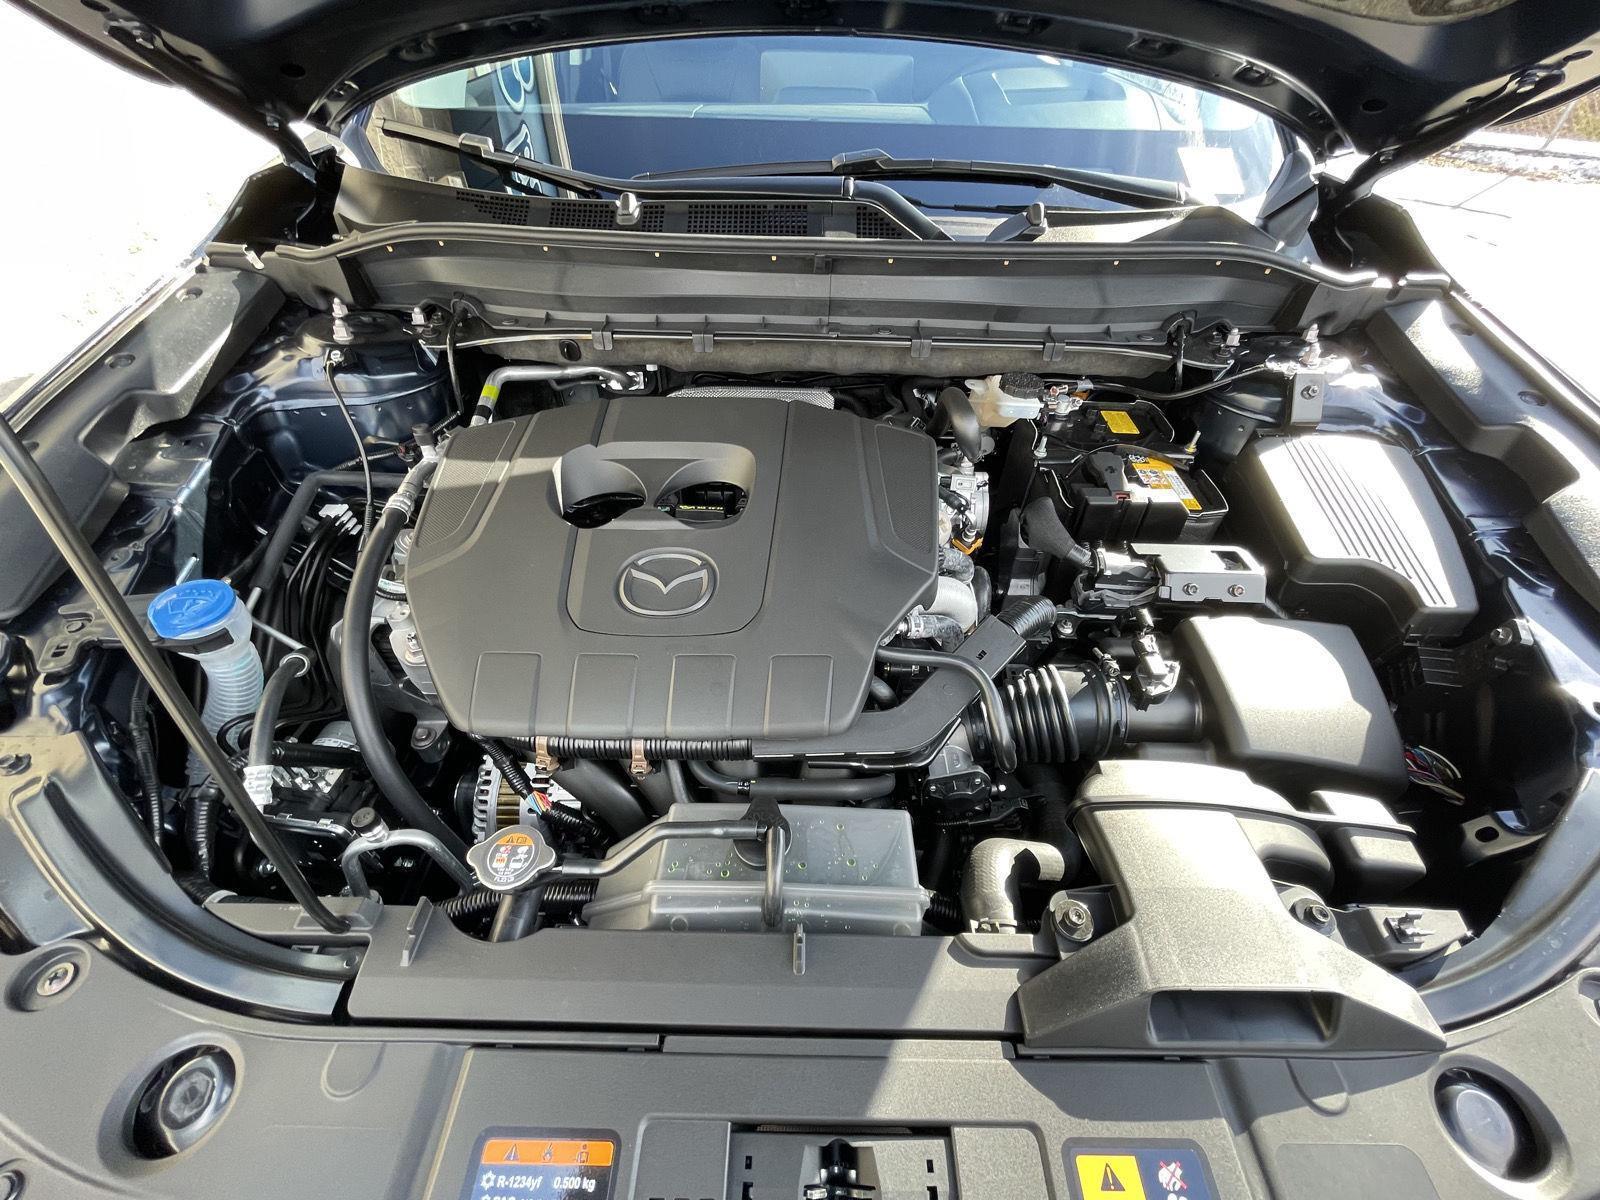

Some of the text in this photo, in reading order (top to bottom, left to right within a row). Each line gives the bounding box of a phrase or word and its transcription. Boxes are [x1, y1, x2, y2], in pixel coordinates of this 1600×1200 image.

[496, 1175, 596, 1192] R-1234yf 0.500 kg
